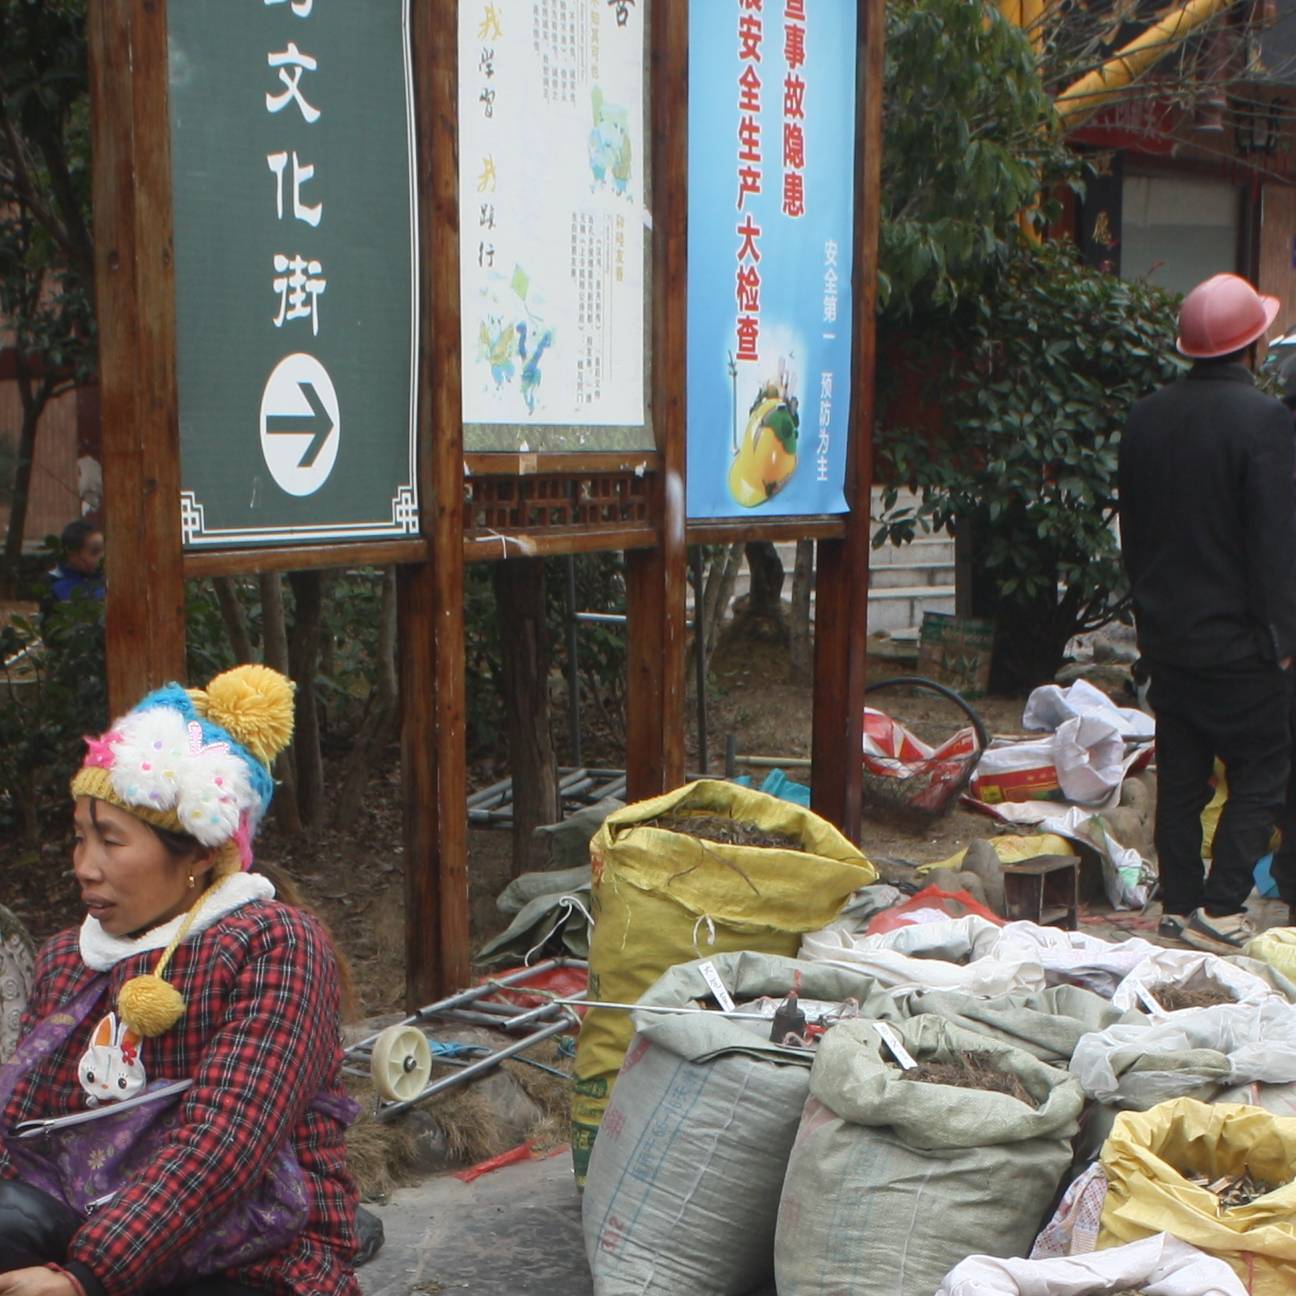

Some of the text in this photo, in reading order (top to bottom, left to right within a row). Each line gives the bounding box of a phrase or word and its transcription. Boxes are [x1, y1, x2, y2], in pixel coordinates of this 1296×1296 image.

[263, 0, 326, 337] 文化街
[735, 0, 763, 362] 安全生产大检查
[814, 239, 838, 482] 安全第一 预防为主
